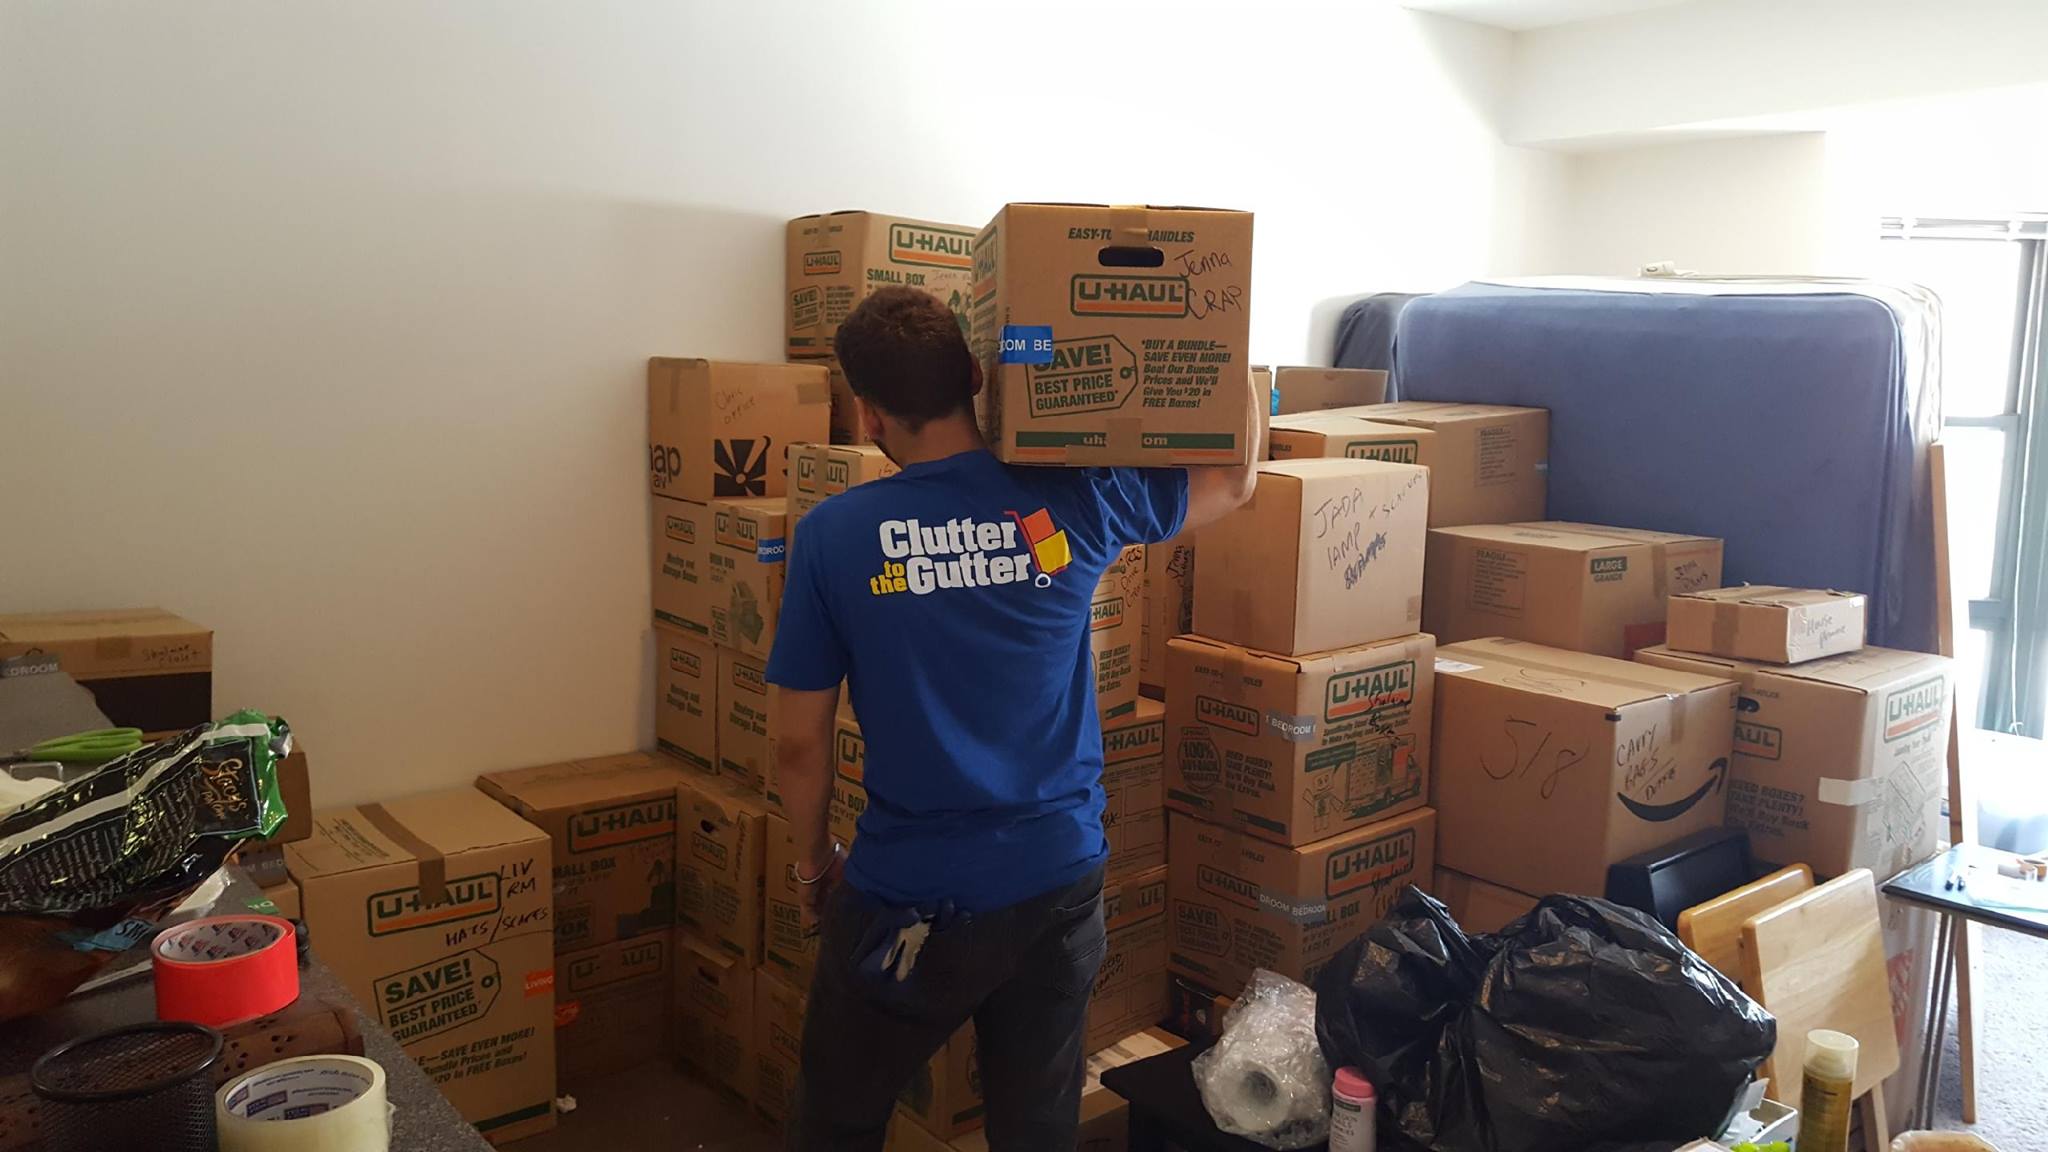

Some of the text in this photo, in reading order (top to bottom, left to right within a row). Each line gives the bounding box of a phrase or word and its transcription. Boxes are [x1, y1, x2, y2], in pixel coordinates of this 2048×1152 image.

[896, 230, 972, 256] U-HAUL
[806, 255, 839, 266] U-HAUL
[867, 268, 926, 286] SMALL BOX
[1078, 281, 1184, 302] U-HAUL
[1187, 284, 1242, 320] CRAP
[1033, 339, 1052, 351] BE
[1167, 340, 1176, 350] A
[1143, 351, 1232, 363] SAVE EVEN MORE!
[1143, 364, 1219, 375] Beat Our Bundle
[1143, 375, 1173, 385] Prices
[1175, 376, 1193, 385] and
[1035, 373, 1113, 395] BEST PRICE
[1143, 387, 1167, 397] Give
[1168, 388, 1183, 397] You
[1202, 388, 1211, 397] in
[1142, 398, 1201, 408] FREE Boxes!
[801, 461, 845, 484] U-UL
[718, 517, 755, 541] U-AUL
[879, 516, 1017, 559] Clutter
[869, 550, 1032, 596] the Gutter
[883, 560, 905, 579] to
[1593, 558, 1625, 571] LARGE
[1593, 572, 1624, 583] GRANDE
[1091, 602, 1122, 622] -HAUL
[1332, 668, 1409, 704] U-HAUL
[1200, 699, 1256, 726] U-HAUL
[1889, 686, 1940, 723] U-HAUL
[576, 801, 675, 838] U-HAUL
[500, 857, 534, 882] LIV
[553, 855, 617, 879] MALL BOX
[1332, 835, 1412, 881] U-HAUL
[506, 876, 536, 899] RM
[1200, 869, 1259, 901] U-HAUL
[1178, 904, 1219, 927] SAVE!
[1340, 900, 1361, 919] BOX
[575, 948, 657, 979] U-AUL
[384, 957, 473, 1005] SAVE!
[389, 987, 476, 1029] BEST PRICE
[470, 1036, 500, 1055] EVEN
[500, 1026, 536, 1045] MORE!
[496, 1046, 514, 1060] and
[466, 1060, 492, 1078] FREE
